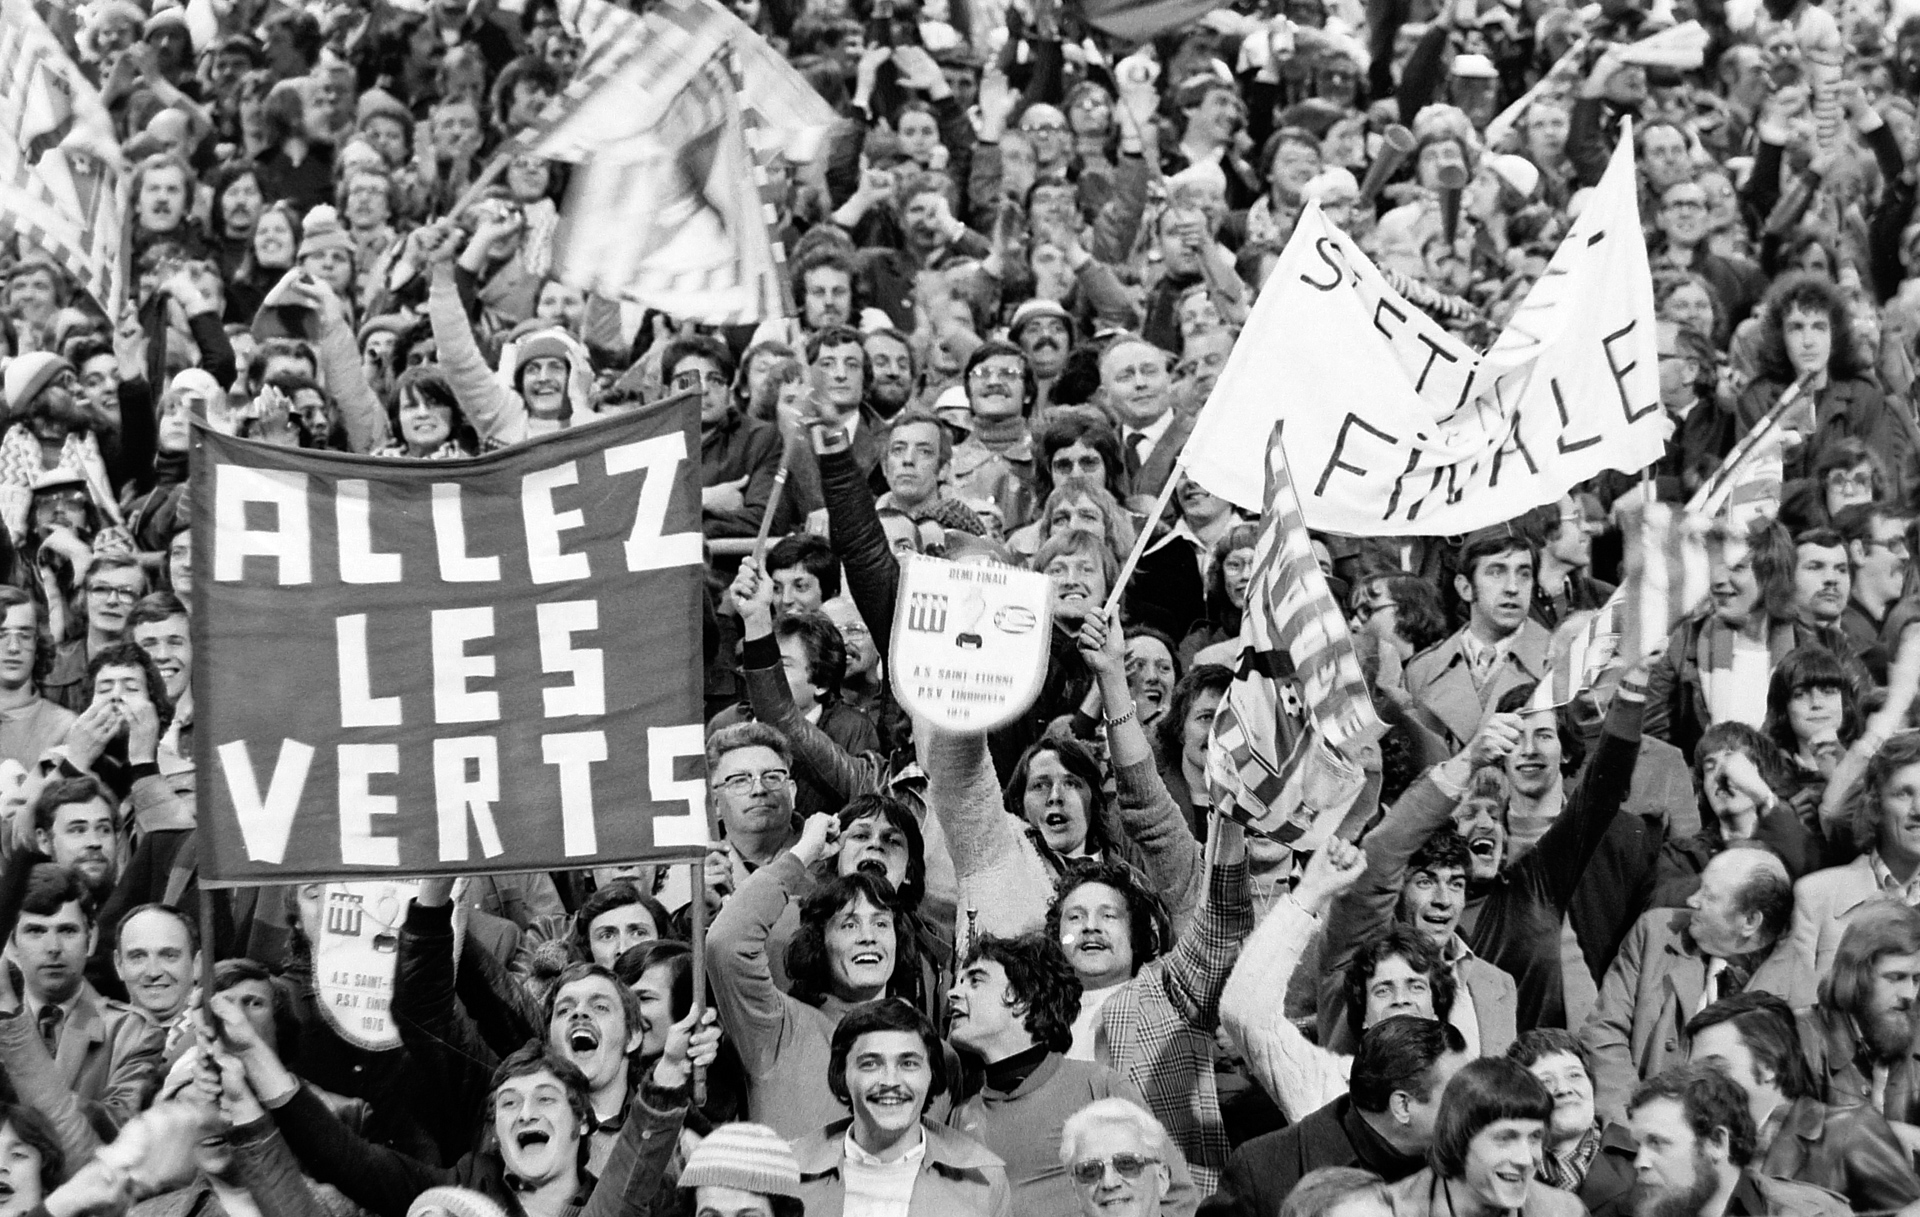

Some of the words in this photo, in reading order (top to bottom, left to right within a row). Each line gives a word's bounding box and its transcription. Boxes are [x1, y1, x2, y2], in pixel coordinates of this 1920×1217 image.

[213, 430, 704, 586] ALLEZ
[949, 568, 973, 581] DEMI
[976, 569, 1008, 585] FINALE
[335, 599, 606, 728] LES
[217, 723, 708, 866] VERTS
[362, 1016, 385, 1032] 1976
